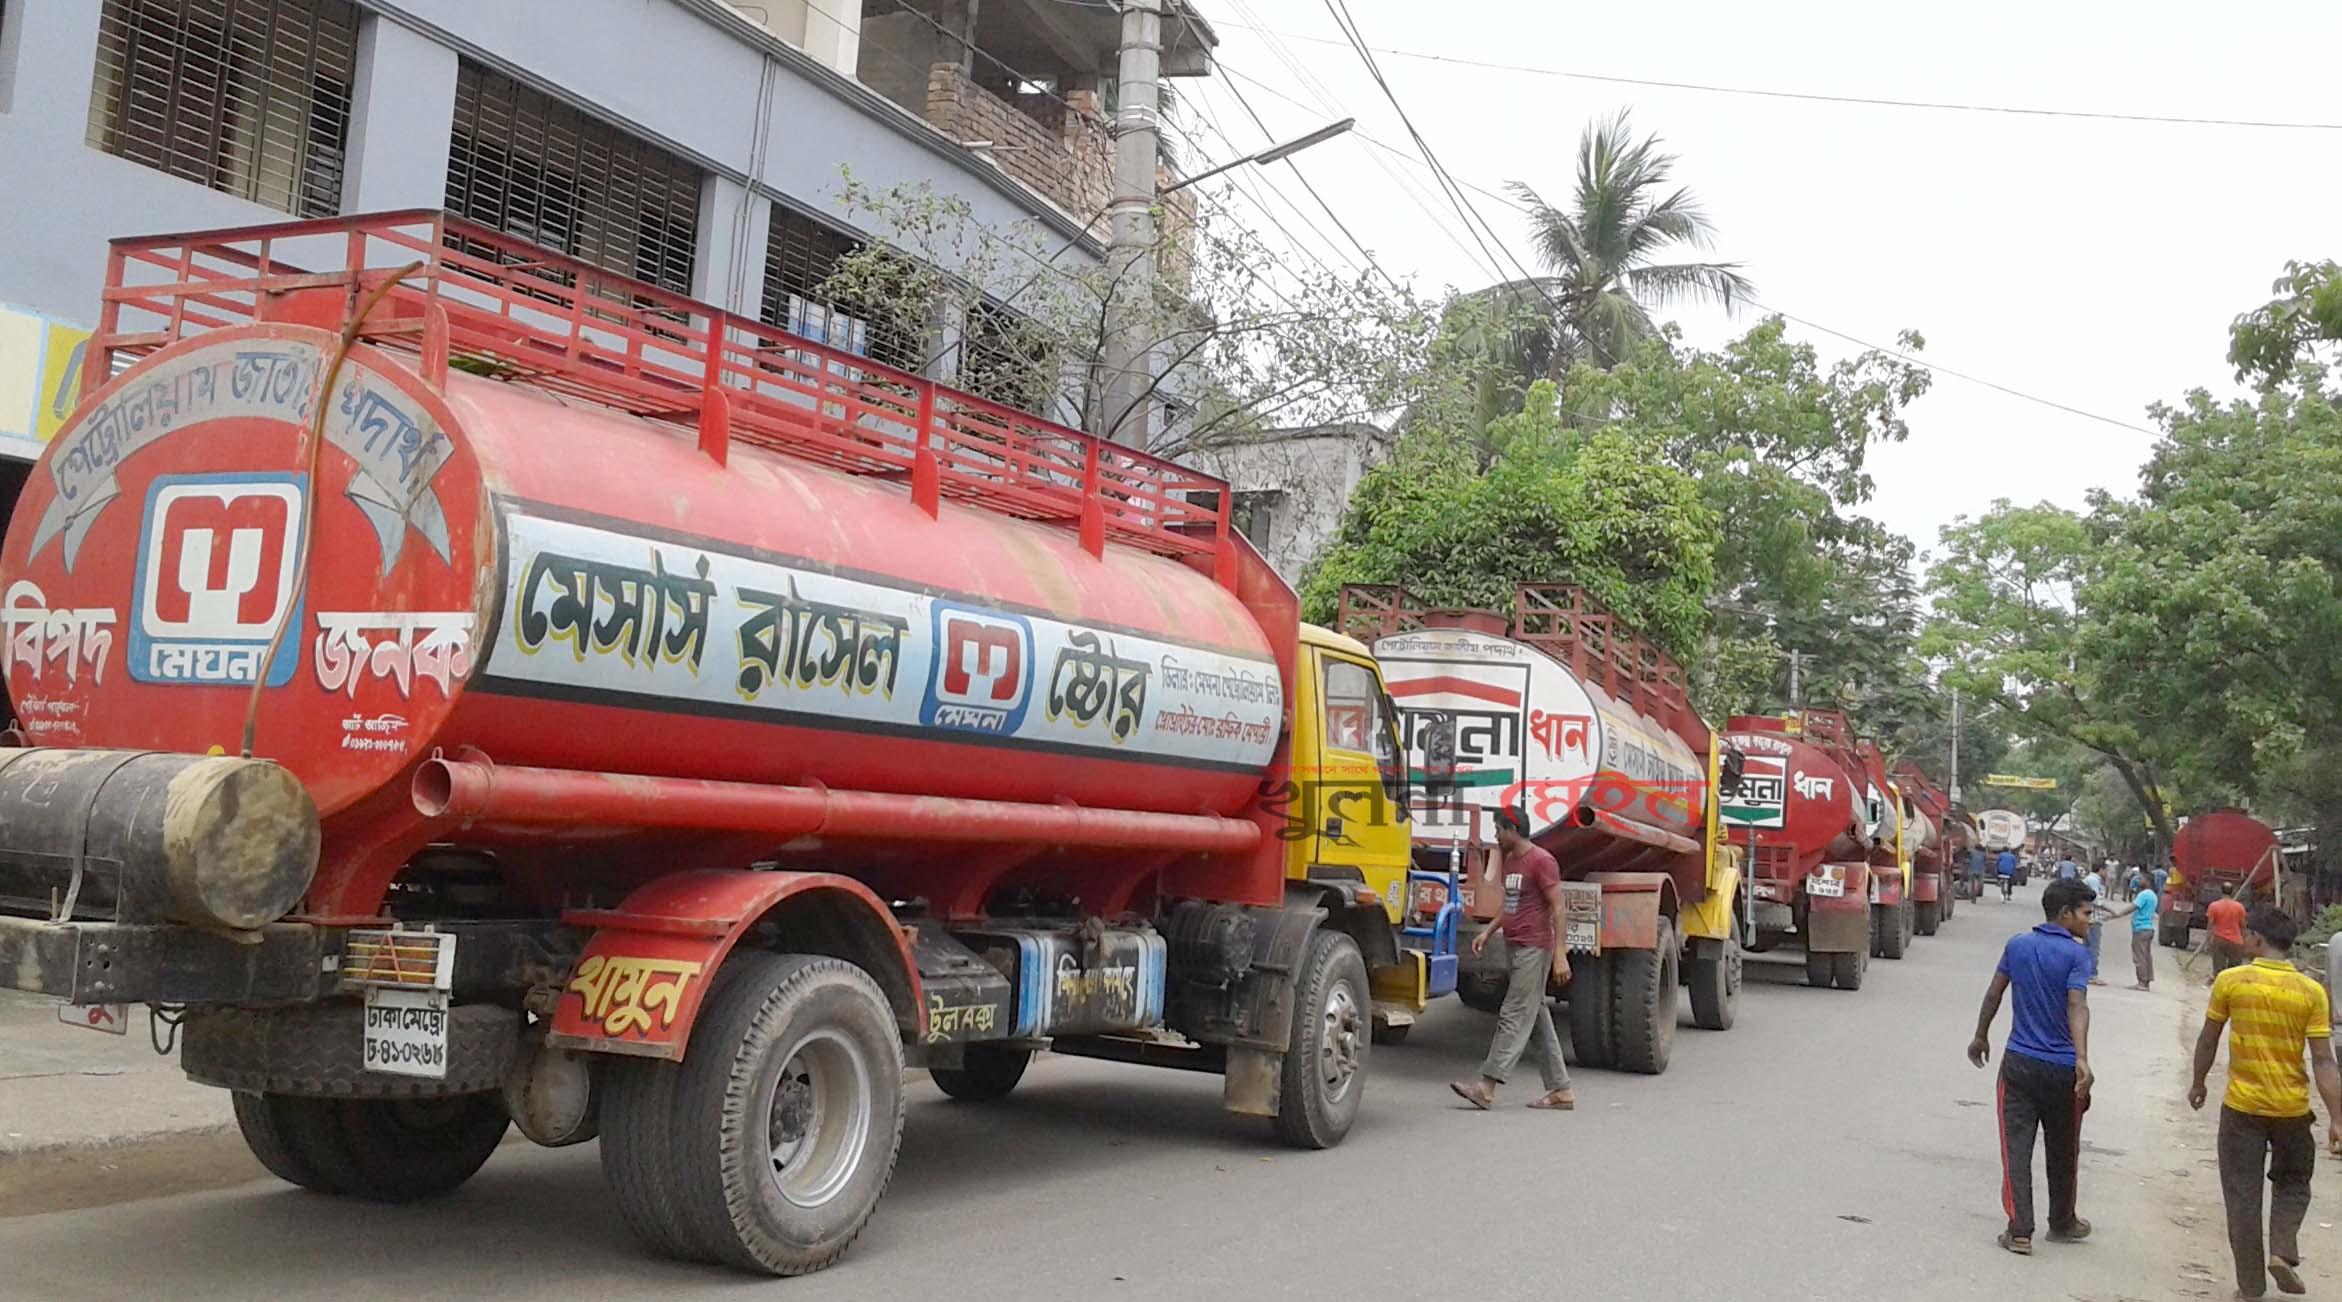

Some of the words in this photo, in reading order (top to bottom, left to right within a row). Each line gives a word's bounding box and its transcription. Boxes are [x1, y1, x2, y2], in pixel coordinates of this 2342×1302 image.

[0, 579, 117, 690] বিপদ
[314, 611, 476, 700] জনক
[514, 546, 718, 676] মেসার্স
[733, 573, 910, 702] রাসেল
[149, 642, 272, 682] মেঘনা
[934, 705, 1007, 733] মেঘনা
[1529, 709, 1591, 763] ধান
[1792, 769, 1834, 801] ধান
[569, 955, 703, 1038] থামুন
